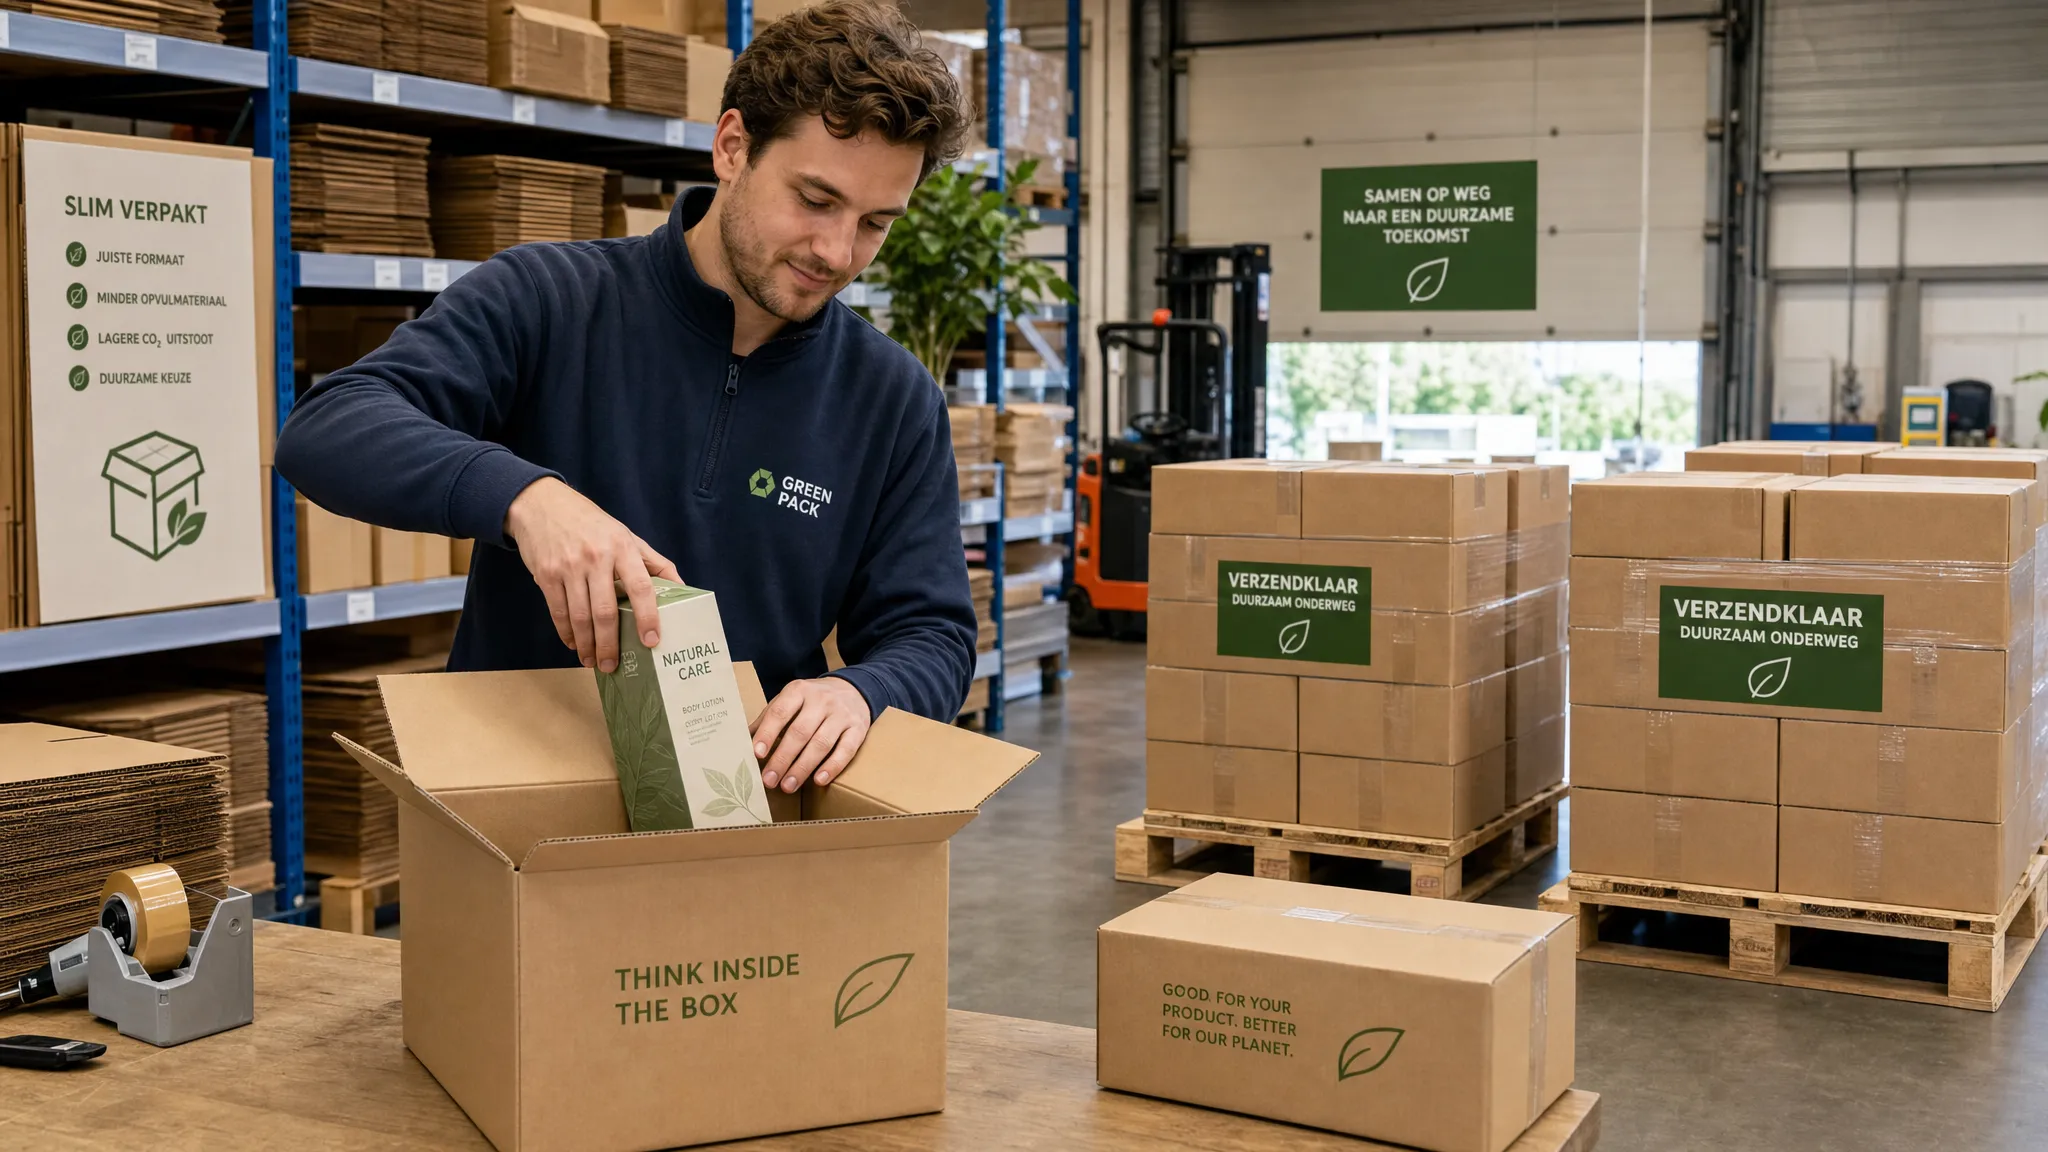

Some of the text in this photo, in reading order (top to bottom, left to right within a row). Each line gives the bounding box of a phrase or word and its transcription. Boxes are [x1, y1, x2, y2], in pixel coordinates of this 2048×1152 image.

[1364, 185, 1491, 204] SAMEN OP WEG
[65, 195, 208, 224] SLIM VERPAKT
[1343, 206, 1515, 225] NAAR EEN DUURZAME
[1383, 227, 1470, 244] TOEKOMST
[96, 251, 185, 266] JUISTE FORMAAT
[97, 292, 227, 307] MINDER OPVULMATERIAAL
[98, 332, 139, 345] LAGERE
[166, 333, 214, 345] UITSTOOT
[99, 372, 192, 385] DUURZAME KEUZE
[782, 475, 833, 504] GREEN
[777, 491, 820, 518] PACK
[1228, 571, 1359, 595] VERZENDKLAAR
[1232, 593, 1356, 612] DUURZAAM ONDERWEG
[1673, 598, 1863, 628] VERZENDKLAAR
[1680, 625, 1859, 649] DUURZAAM ONDERWEG
[662, 641, 719, 668] NATURAL
[678, 660, 712, 681] CARE
[682, 696, 725, 715] BODY LOTION
[615, 953, 800, 991] THINK INSIDE
[615, 992, 738, 1025] THE BOX
[1216, 991, 1246, 1008] FOR
[1250, 996, 1292, 1015] YOUR
[1162, 1003, 1297, 1037] PRODUCT. BETTER
[1162, 1024, 1294, 1058] FOR OUR PLANET.
